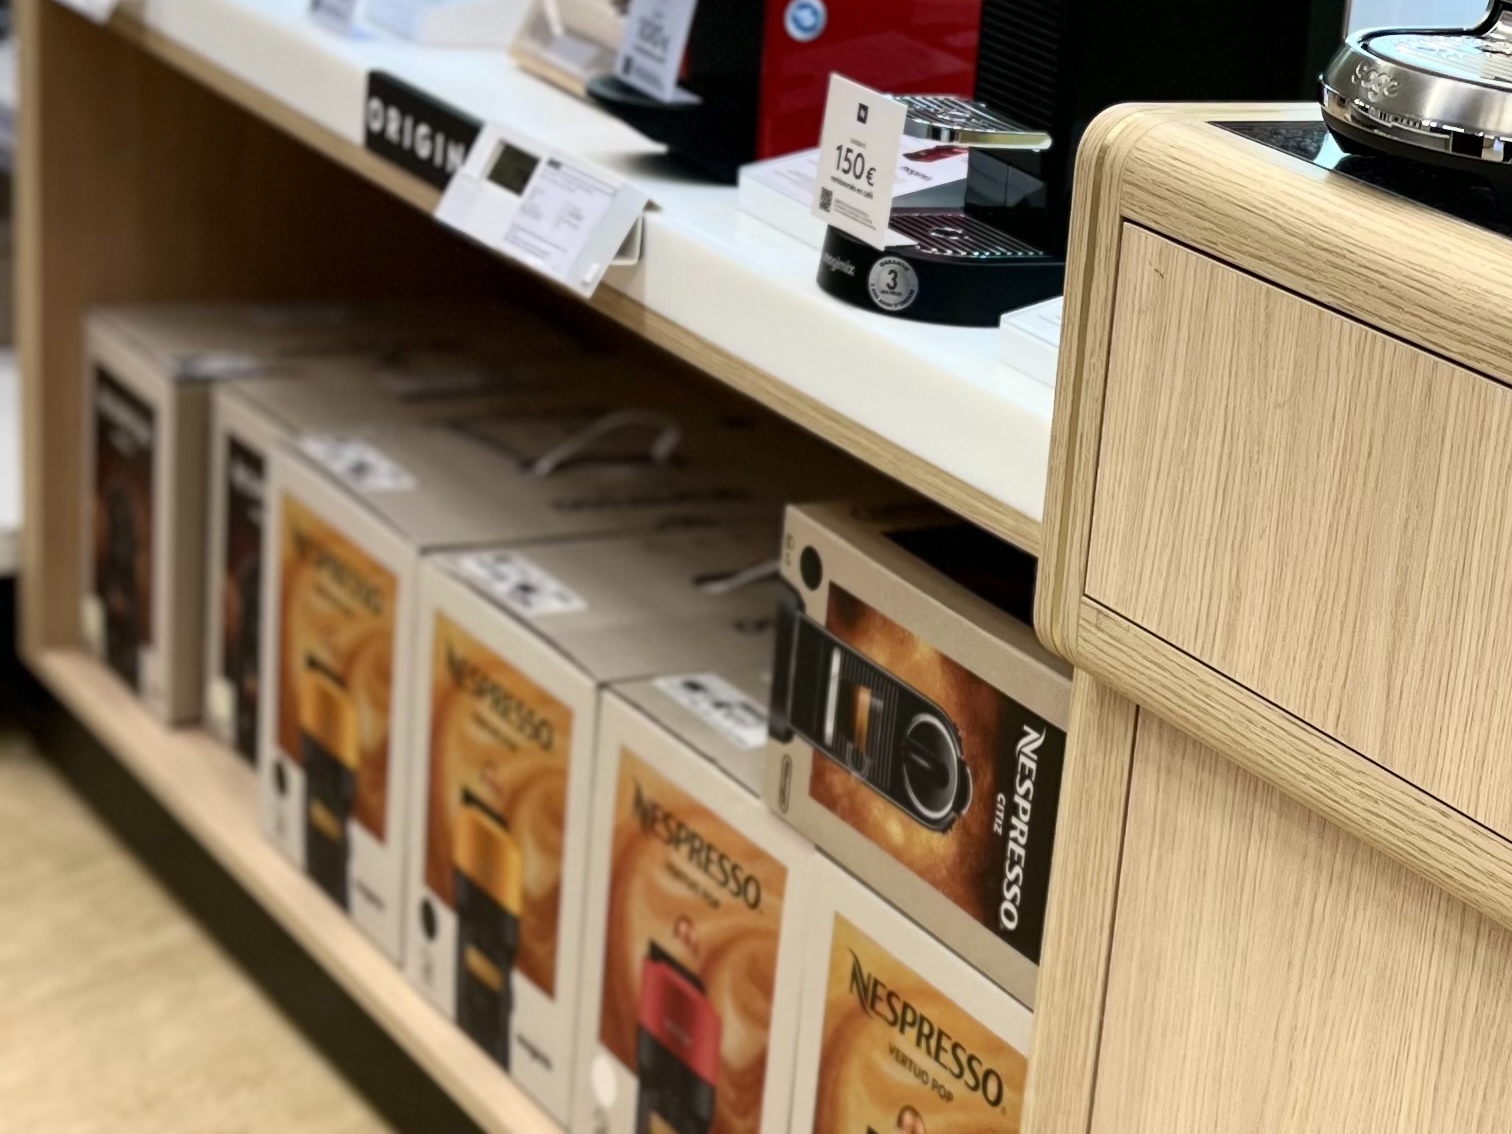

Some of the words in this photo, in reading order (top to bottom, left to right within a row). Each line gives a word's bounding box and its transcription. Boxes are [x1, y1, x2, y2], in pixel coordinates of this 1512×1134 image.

[886, 269, 898, 291] 3
[631, 774, 762, 911] NESPRESSO
[993, 791, 1006, 837] CITIZ
[1000, 723, 1047, 932] NESPRESSO
[847, 946, 1005, 1108] NESPRESSO
[888, 1040, 930, 1086] VERTUO
[930, 1075, 955, 1104] POP
